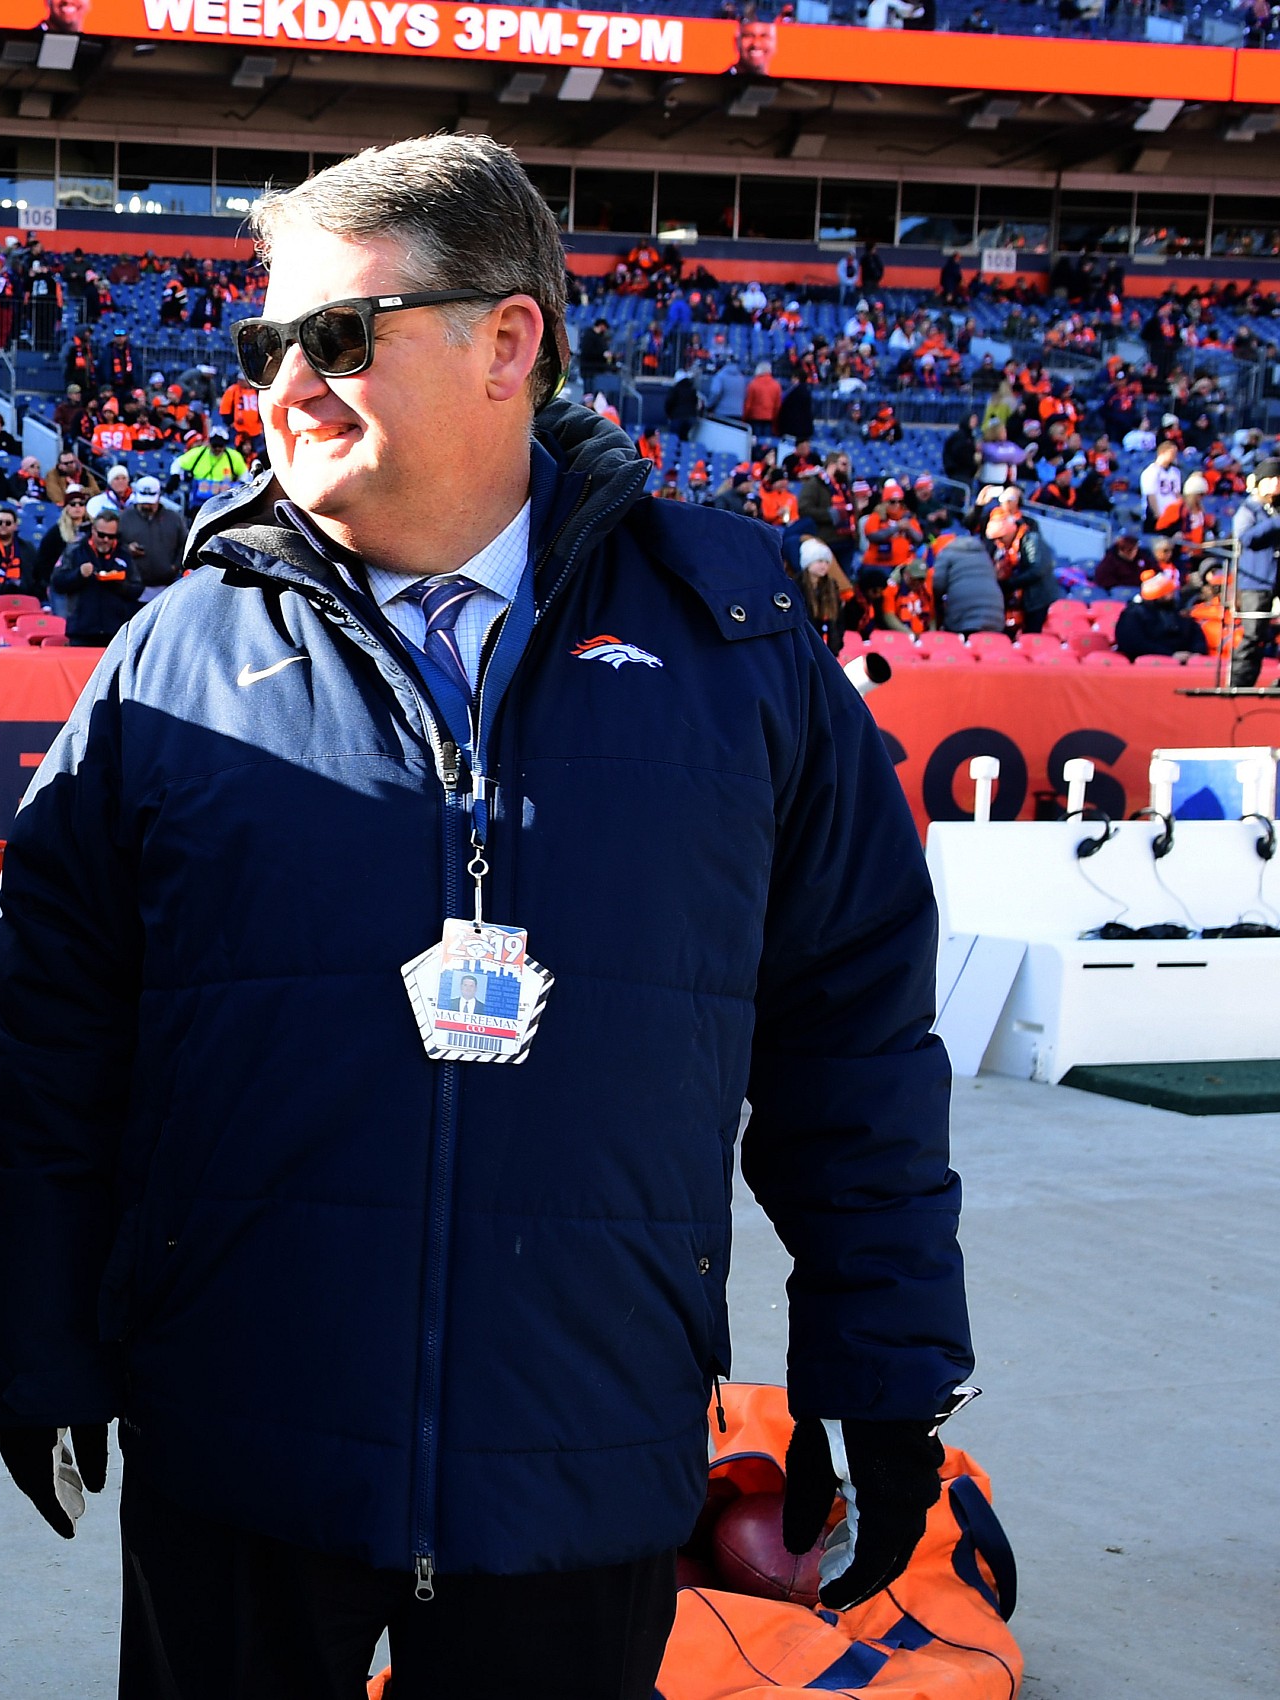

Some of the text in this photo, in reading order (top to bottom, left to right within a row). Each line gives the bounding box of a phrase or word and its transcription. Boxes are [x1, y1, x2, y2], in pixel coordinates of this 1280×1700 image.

[143, 0, 683, 64] WEEKDAYS 3PM-7PM
[24, 209, 53, 226] 106
[434, 1010, 518, 1029] MAC FREEMAN
[466, 1024, 486, 1033] CCO
